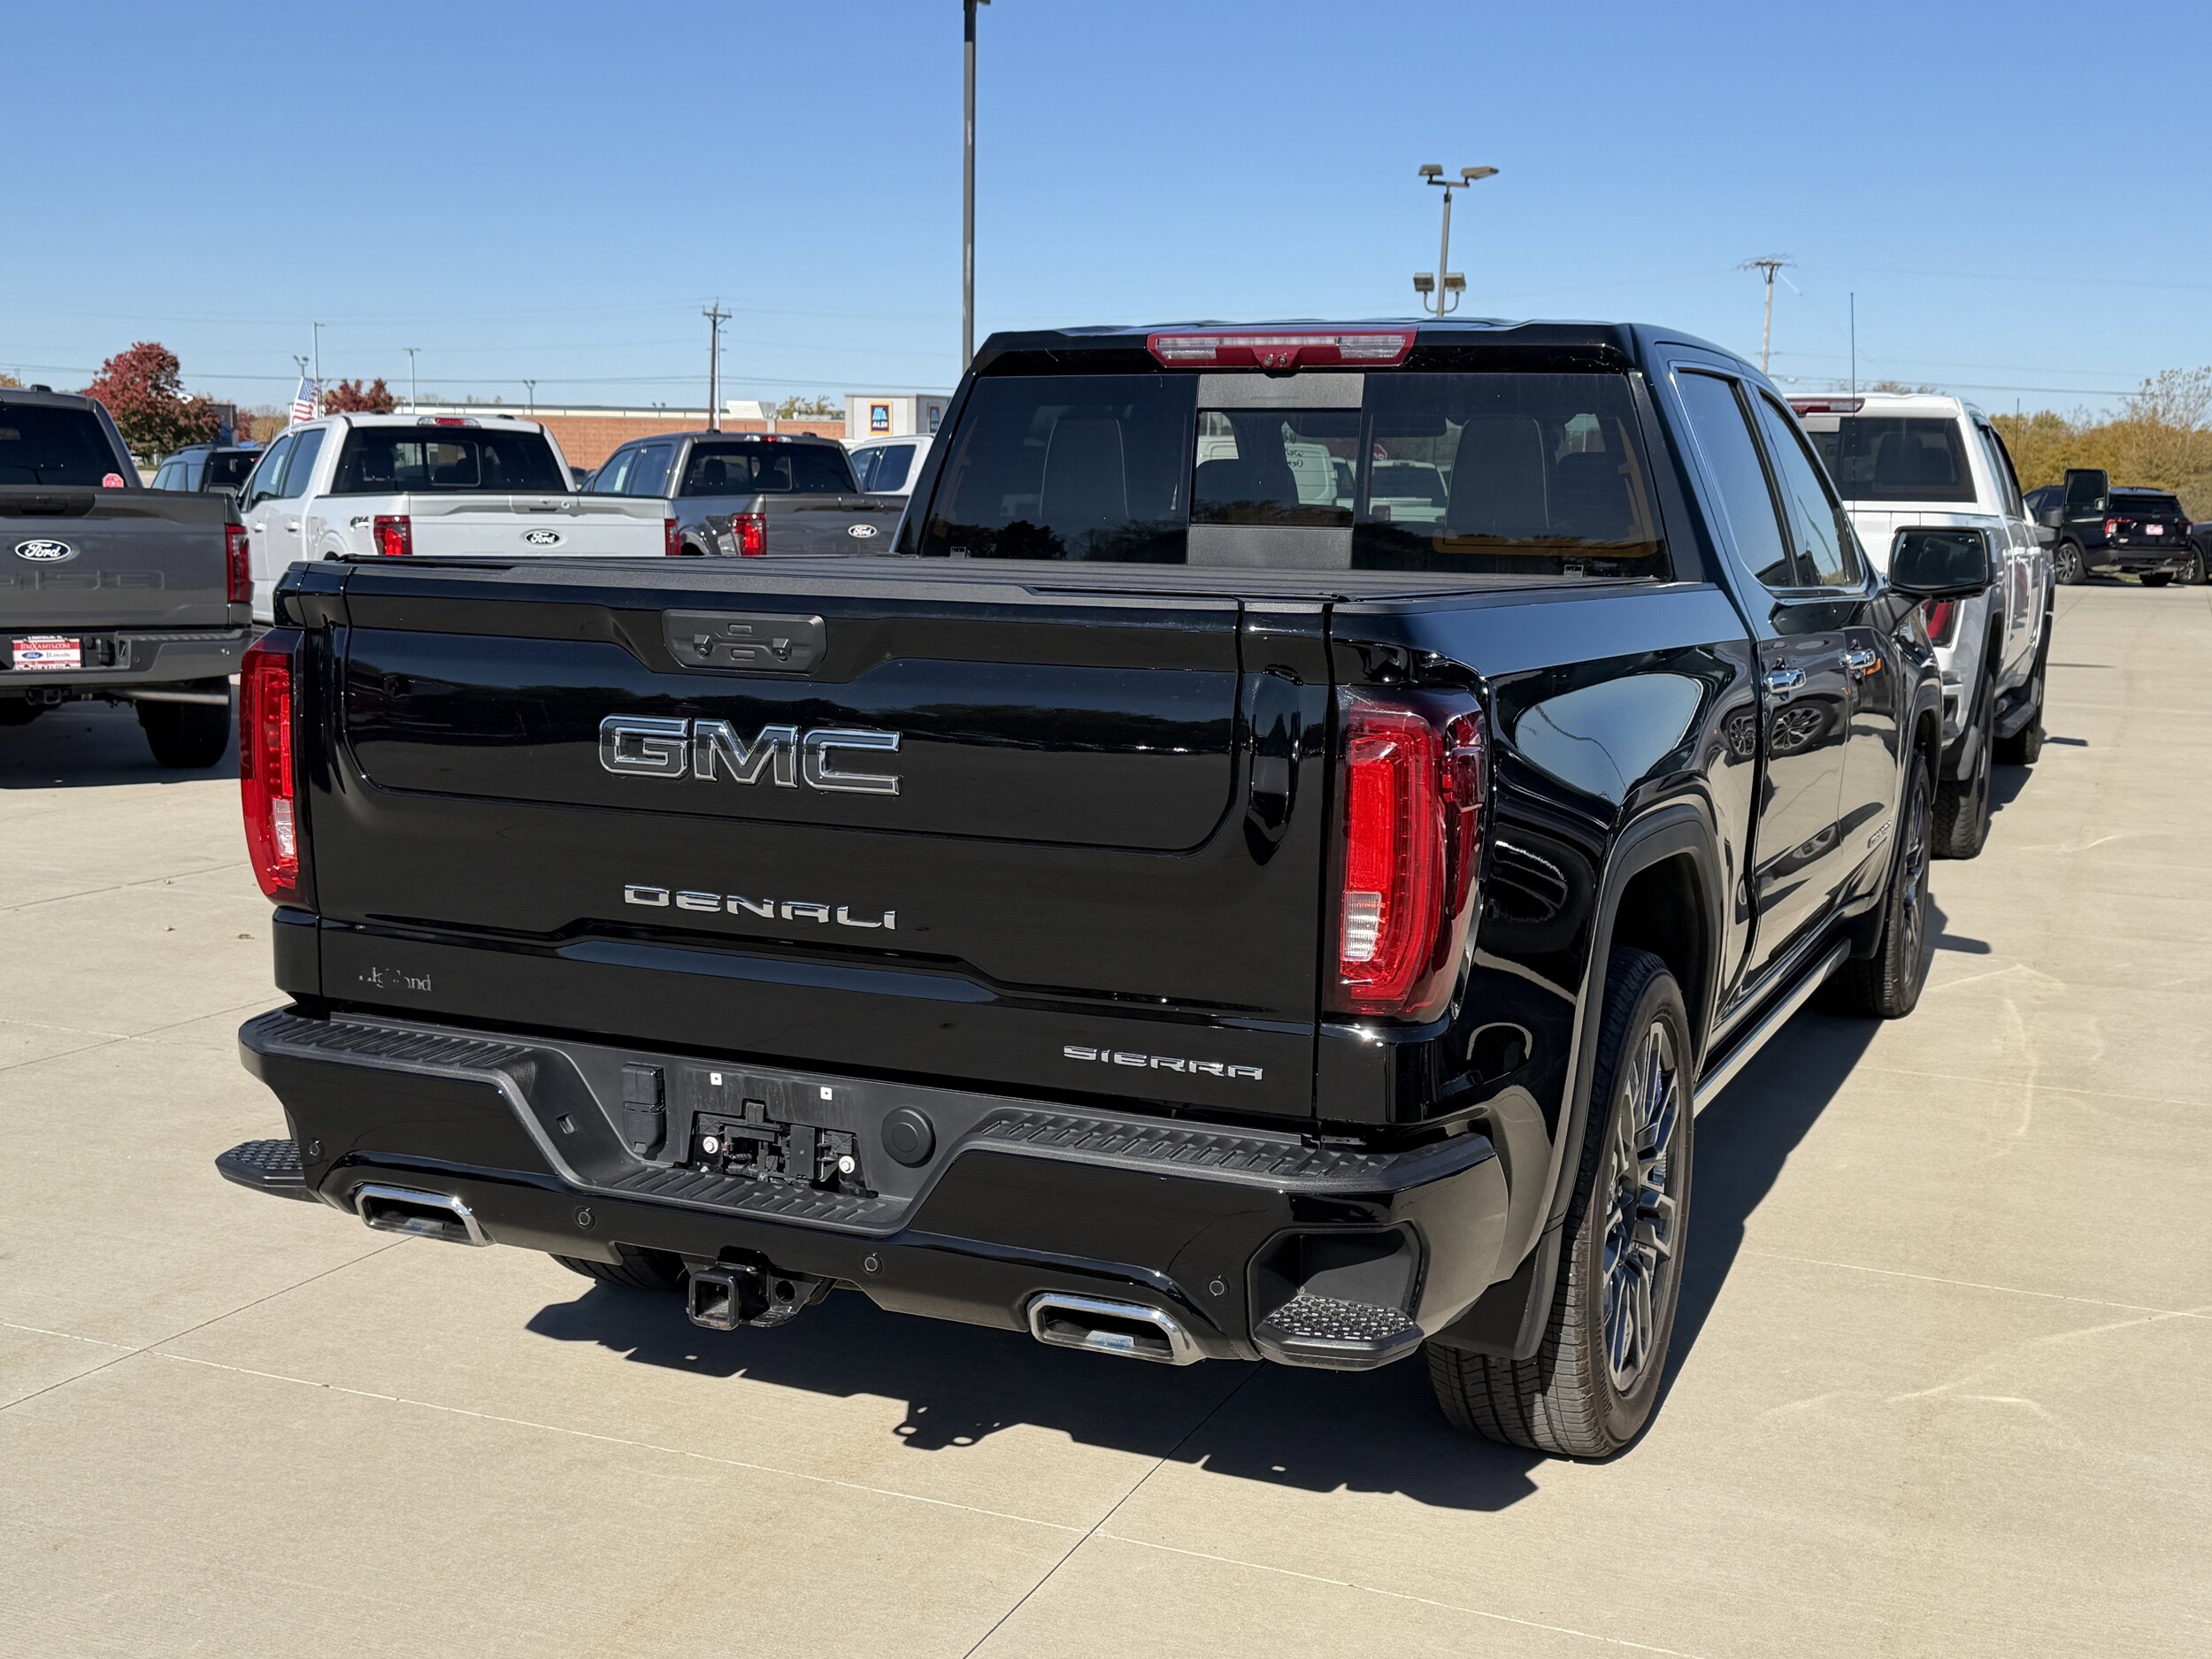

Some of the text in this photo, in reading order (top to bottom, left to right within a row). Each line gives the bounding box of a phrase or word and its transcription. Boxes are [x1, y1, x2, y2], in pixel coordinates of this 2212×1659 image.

[23, 541, 63, 558] Ford
[529, 531, 557, 544] Ford
[600, 713, 902, 795] GMC
[625, 885, 896, 930] DENALI
[1064, 1045, 1263, 1080] SIERRA
